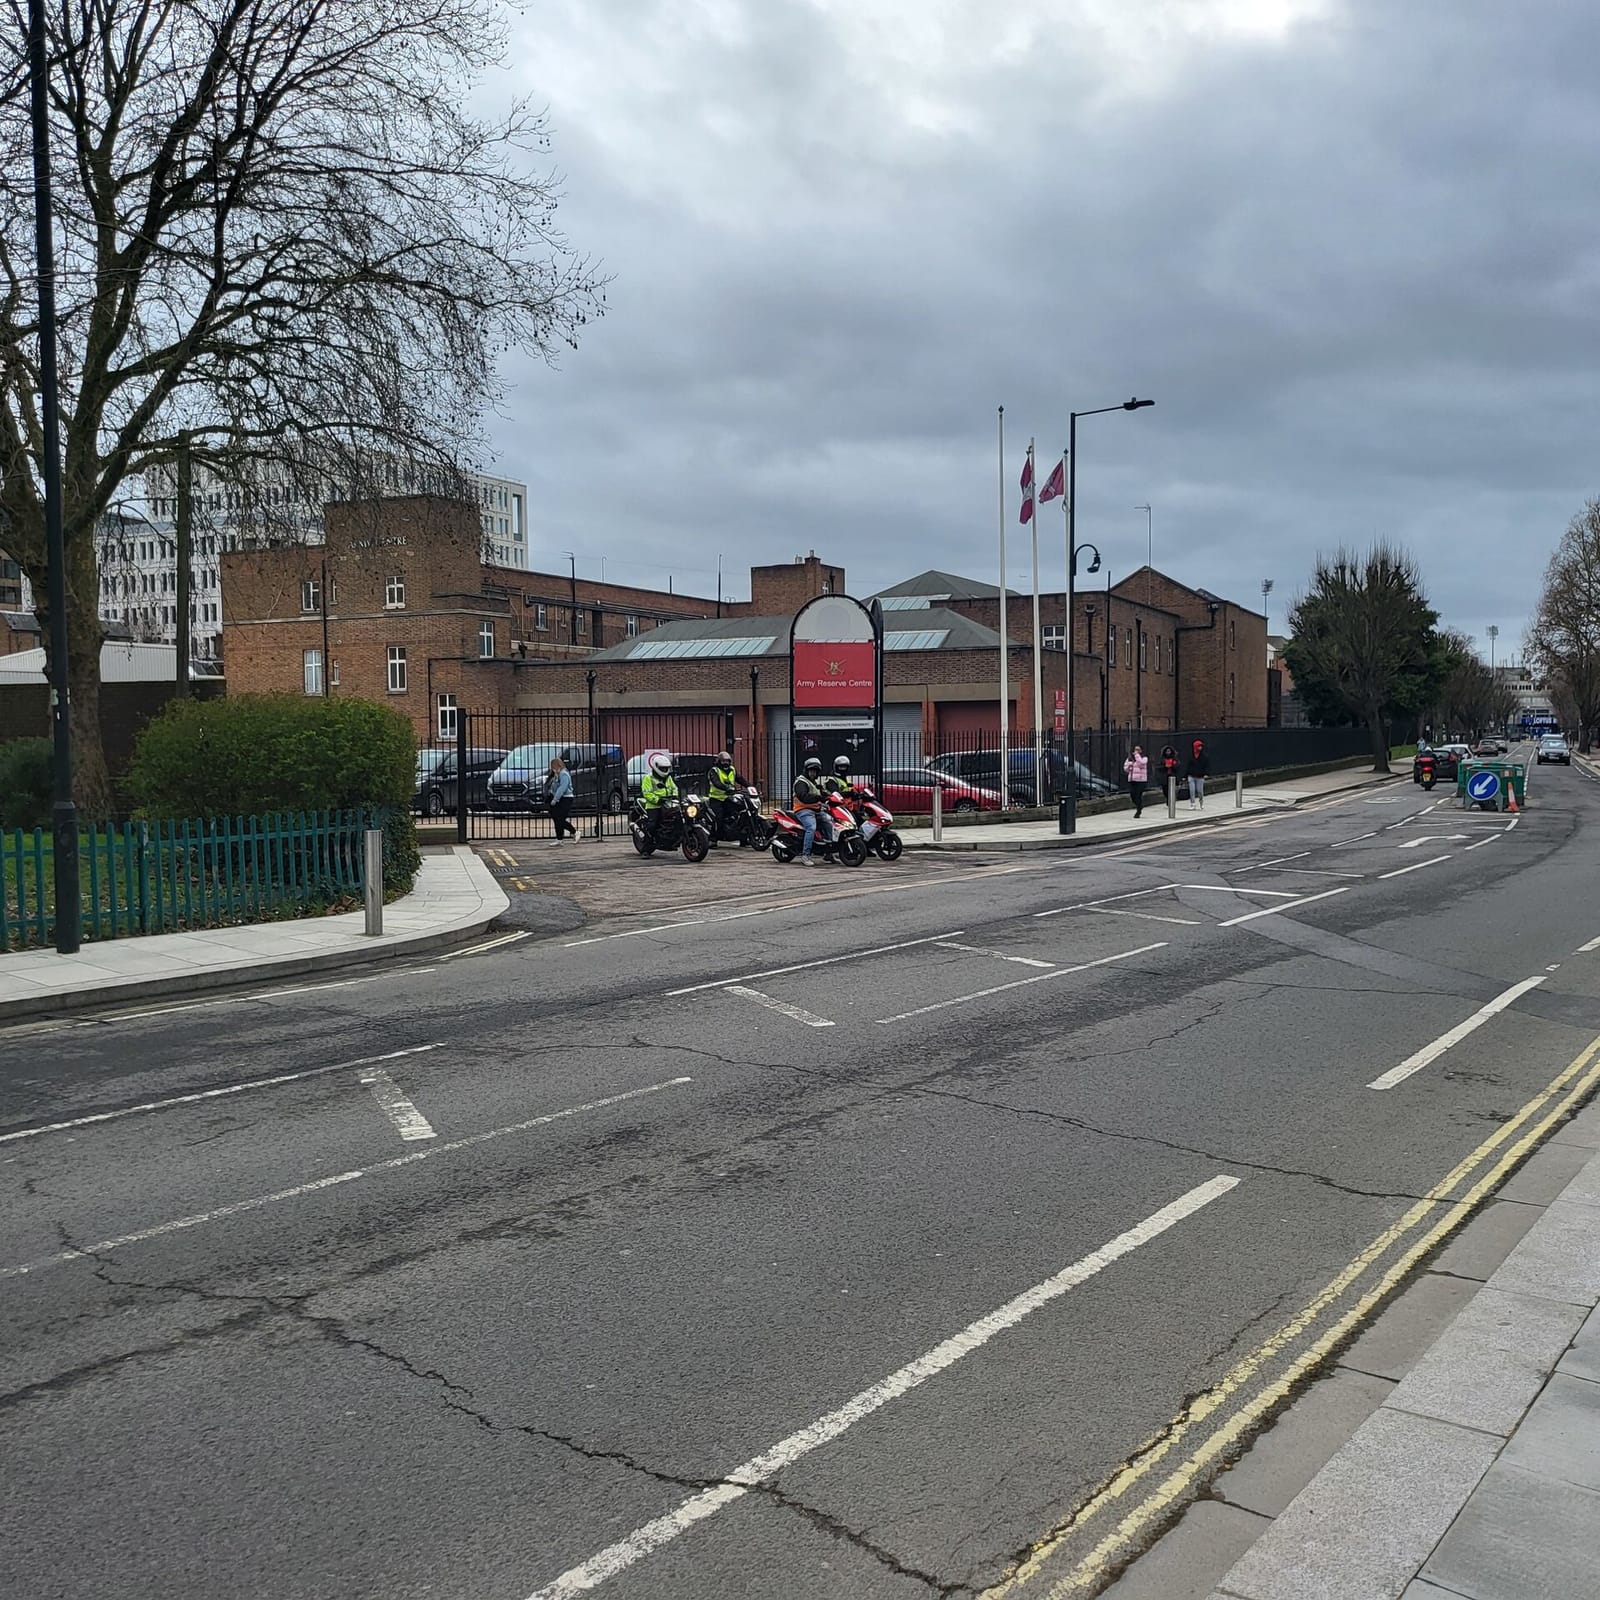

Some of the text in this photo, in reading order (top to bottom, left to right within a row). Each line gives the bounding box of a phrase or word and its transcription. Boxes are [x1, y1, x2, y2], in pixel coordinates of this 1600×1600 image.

[797, 679, 873, 688] Army Reserve Centre
